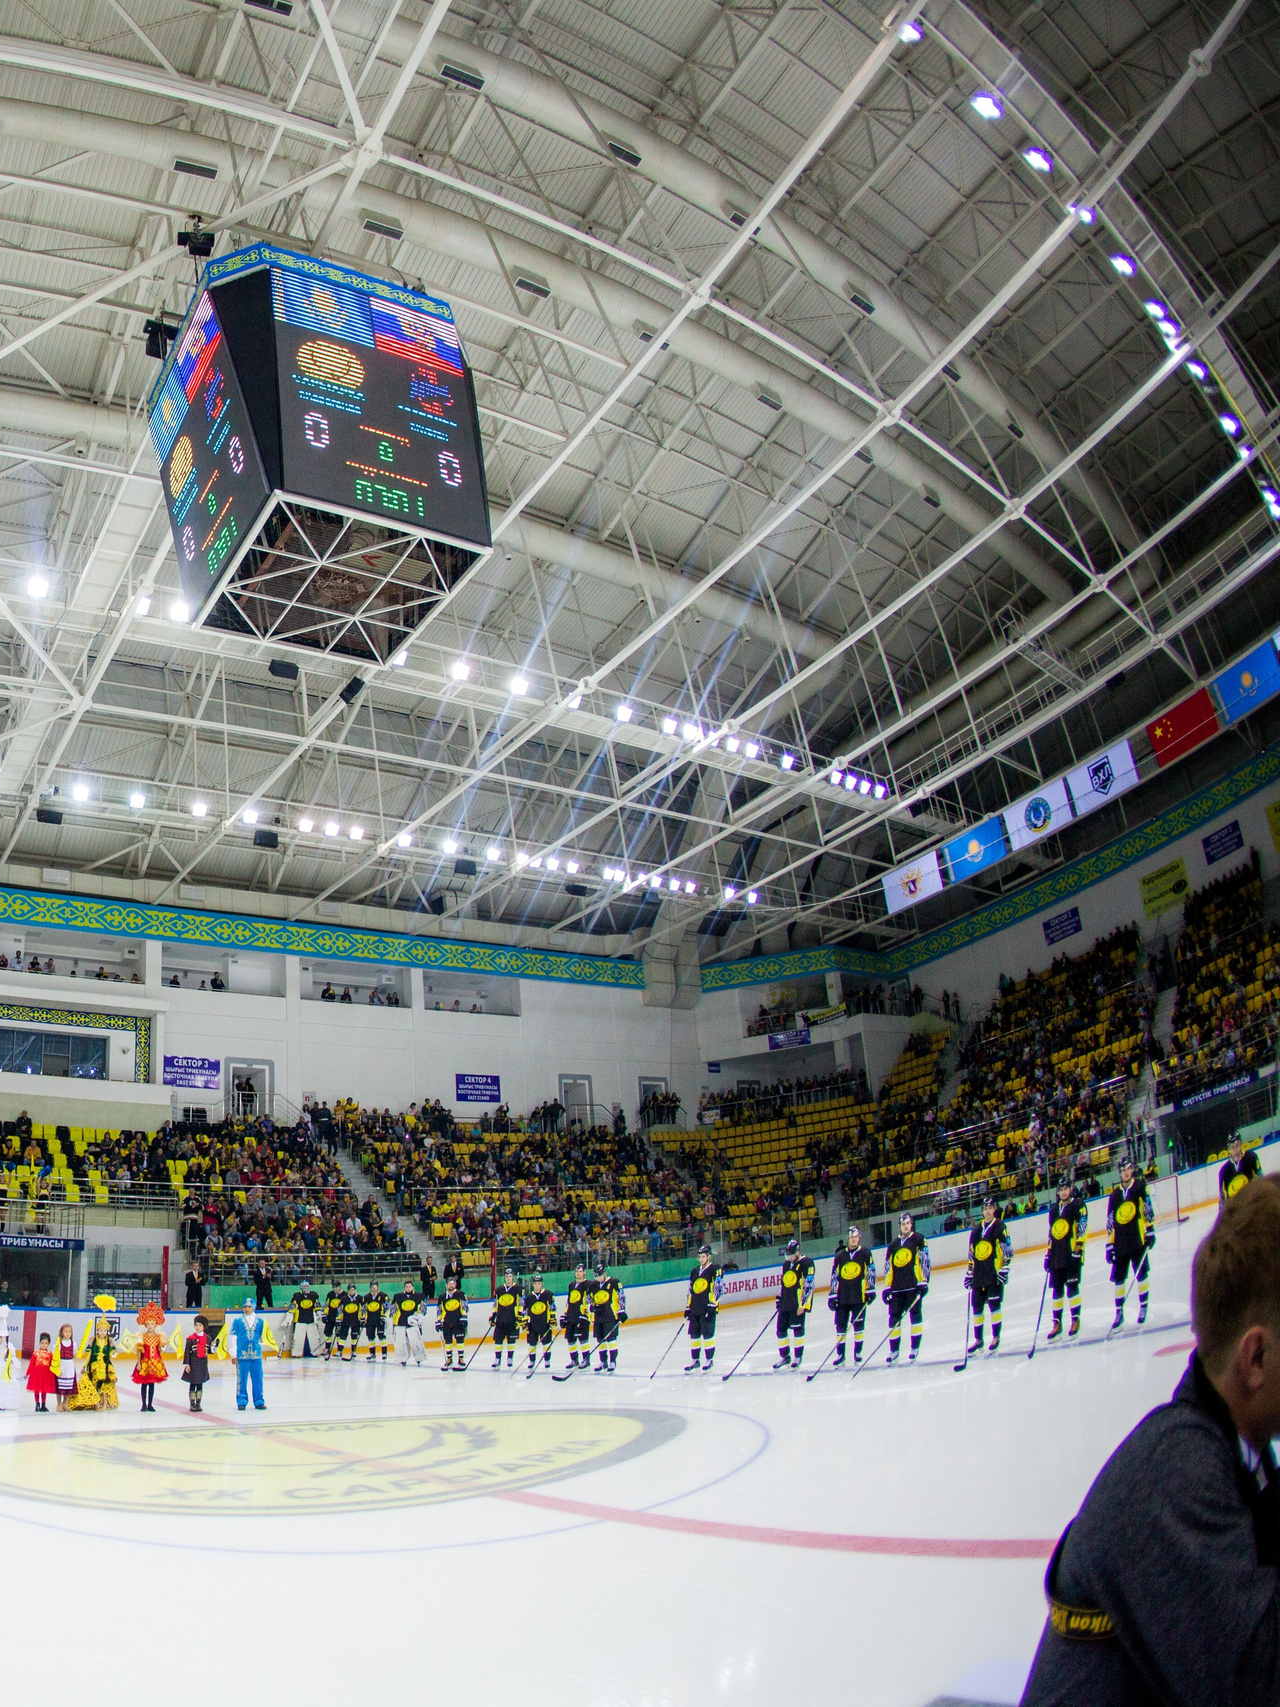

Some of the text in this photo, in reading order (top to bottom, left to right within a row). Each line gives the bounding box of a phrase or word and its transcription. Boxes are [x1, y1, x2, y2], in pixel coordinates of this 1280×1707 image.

[173, 1058, 209, 1068] СЕКТОР 3
[186, 1068, 217, 1076] ТРИБУНАСЫ
[464, 1076, 487, 1084] СЕКТОР
[1, 1236, 64, 1248] ТРИБУНАСЫ
[147, 1486, 254, 1502] ХК
